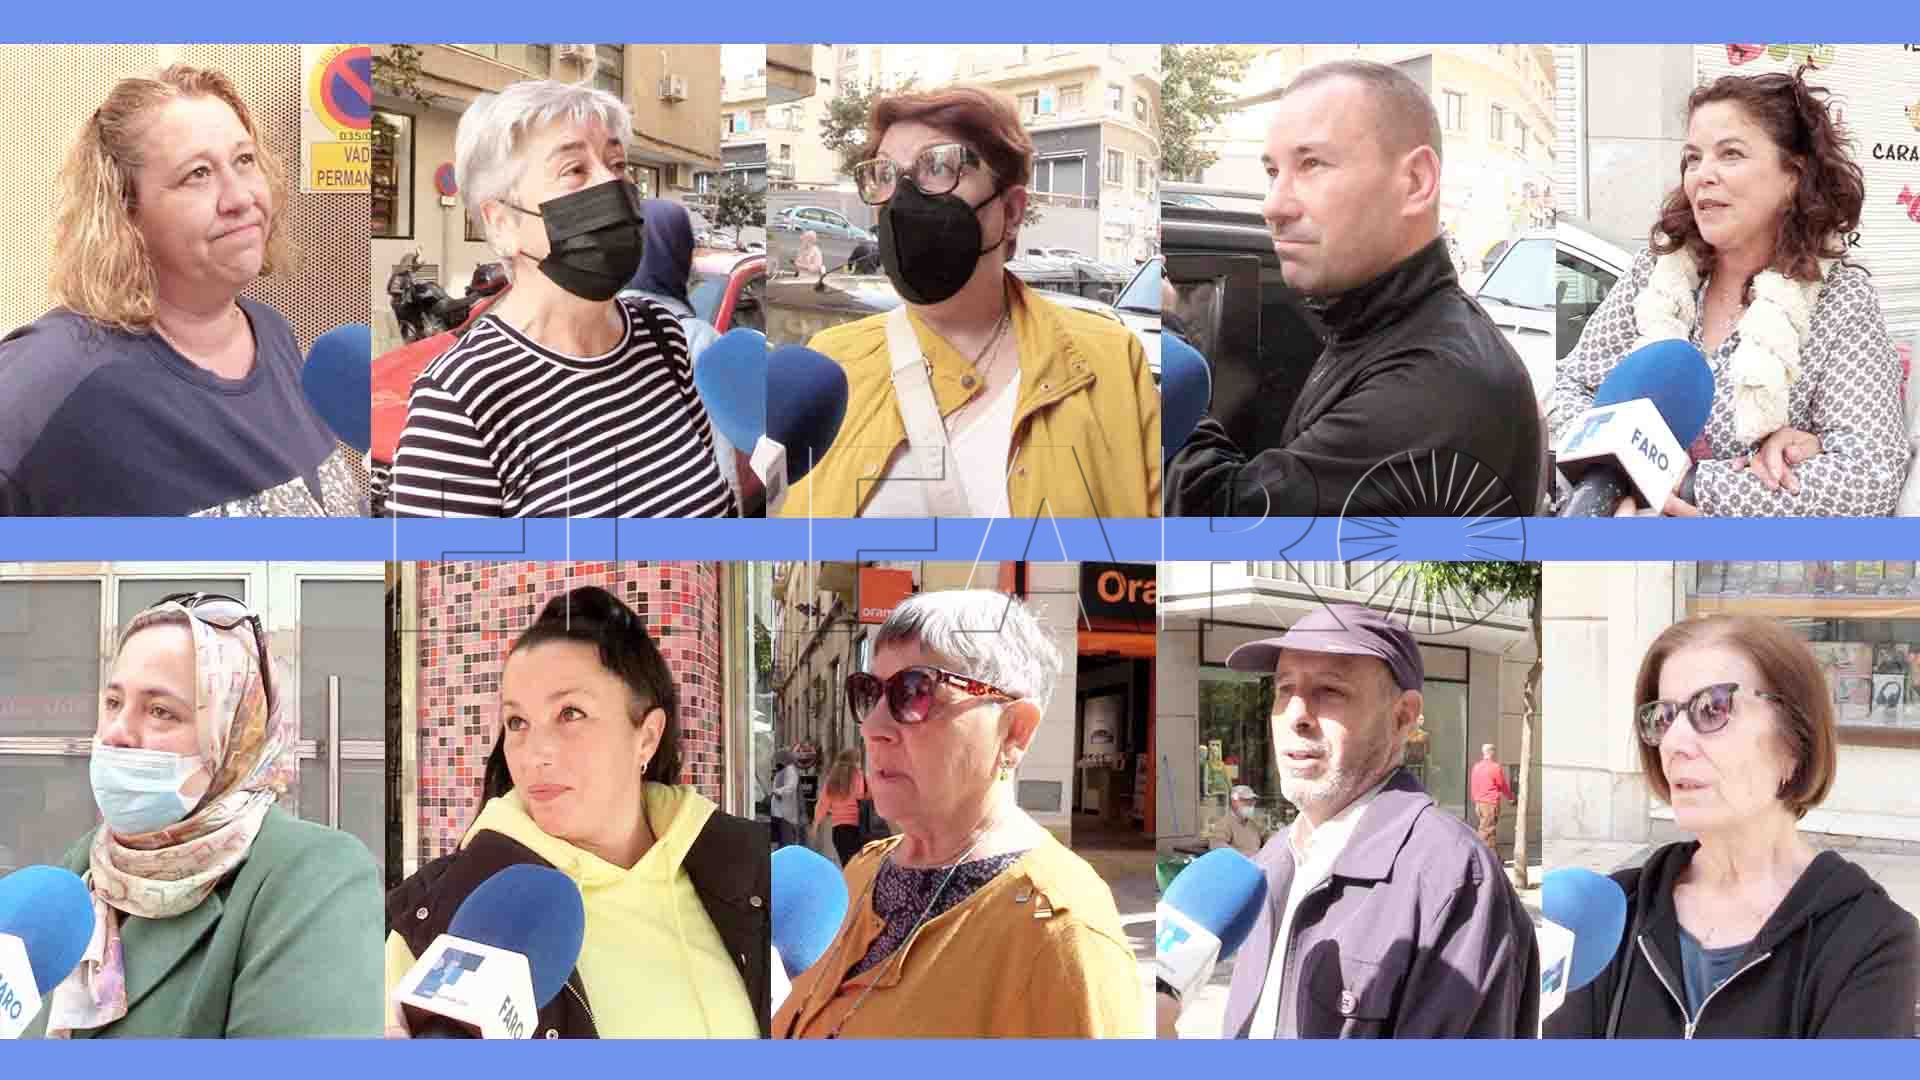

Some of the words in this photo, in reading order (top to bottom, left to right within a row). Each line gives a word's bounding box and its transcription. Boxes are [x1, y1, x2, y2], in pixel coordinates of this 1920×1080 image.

[1631, 427, 1669, 471] FARO
[1097, 569, 1156, 605] Ora
[0, 972, 22, 1019] ARO
[498, 994, 524, 1039] FARO
